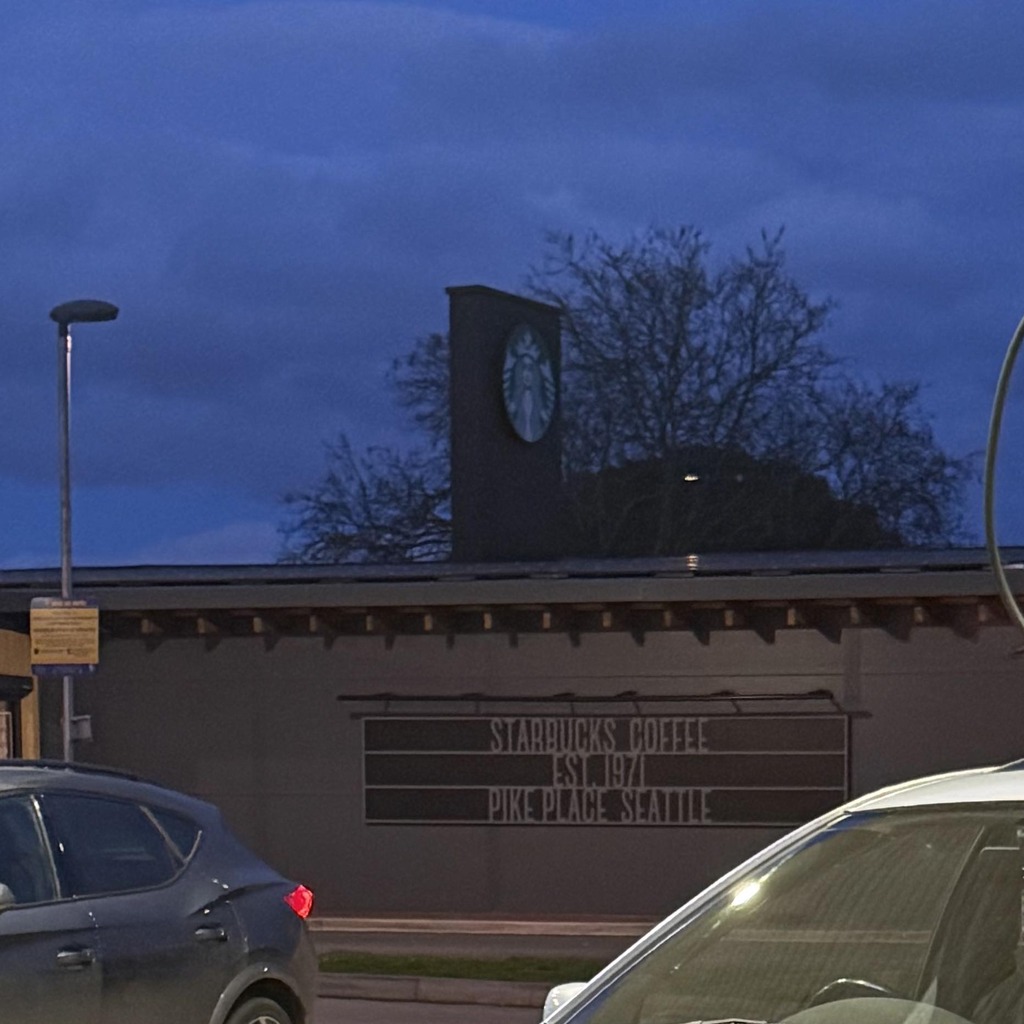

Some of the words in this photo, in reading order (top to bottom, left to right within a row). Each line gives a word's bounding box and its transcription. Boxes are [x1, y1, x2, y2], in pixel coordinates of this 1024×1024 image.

[490, 717, 616, 753] STARBUCKS
[629, 717, 709, 753] COFFEE
[553, 753, 596, 788] EST.
[604, 753, 645, 788] 1971
[488, 787, 534, 822] PIKE
[542, 787, 607, 822] PLACE
[621, 788, 712, 823] SEATTLE
